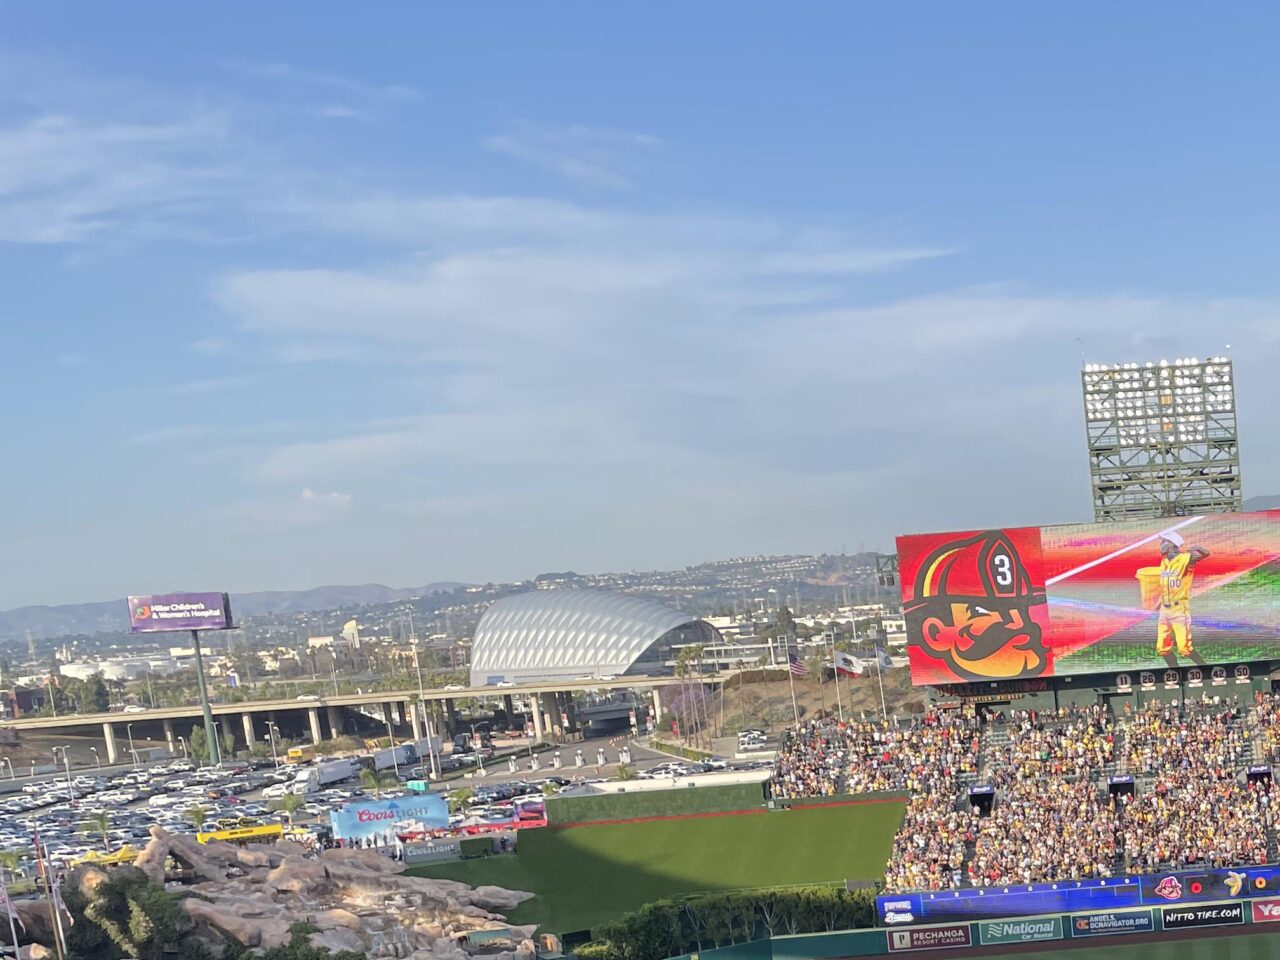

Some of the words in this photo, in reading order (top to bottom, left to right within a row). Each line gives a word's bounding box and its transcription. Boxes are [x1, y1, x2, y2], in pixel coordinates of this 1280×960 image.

[993, 554, 1013, 586] 3
[191, 608, 221, 618] Hospital
[1189, 671, 1201, 680] 30
[1212, 669, 1224, 678] 42
[1236, 667, 1248, 676] 50
[1119, 676, 1128, 685] 11
[1142, 674, 1154, 684] 26
[1166, 673, 1177, 682] 29
[357, 808, 395, 823] Coors
[396, 806, 429, 818] LIGHT
[406, 845, 432, 856] Coors
[432, 844, 455, 853] LIGHT
[1166, 910, 1195, 923] NITTO
[1196, 907, 1241, 920] TIRE.COM
[1003, 920, 1054, 935] National
[1089, 917, 1149, 929] OCNAVIGATOR.ORG
[912, 929, 965, 940] PECHANGA
[941, 936, 966, 944] CASINO
